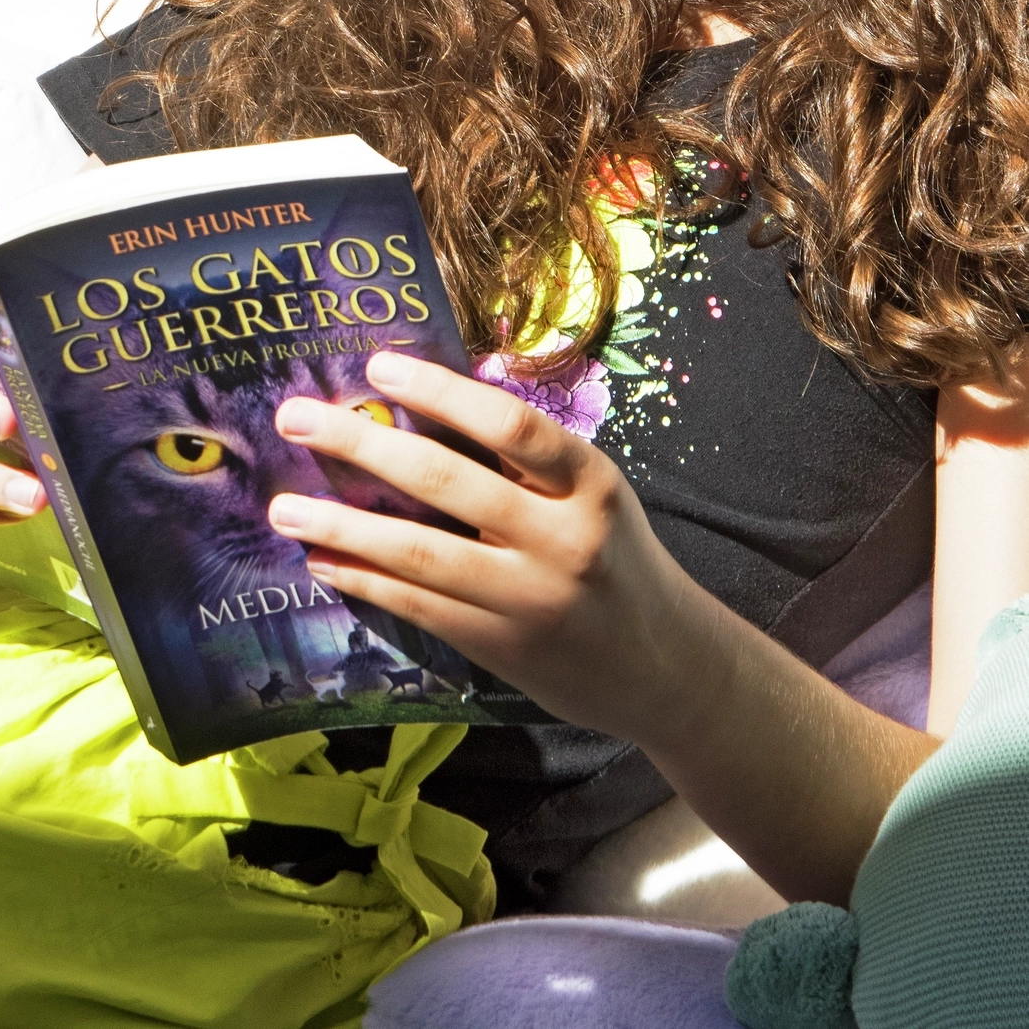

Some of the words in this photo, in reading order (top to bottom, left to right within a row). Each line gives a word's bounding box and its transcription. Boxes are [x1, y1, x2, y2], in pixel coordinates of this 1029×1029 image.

[108, 221, 178, 256] ERIN
[186, 201, 312, 239] HUNTER
[36, 267, 167, 335] LOS
[191, 234, 417, 296] GATOS
[61, 283, 431, 375] GUERREROS
[138, 368, 168, 387] LA
[173, 350, 257, 378] NUEVA
[52, 478, 96, 573] MEDIANOCHE
[198, 579, 344, 630] MEDIA
